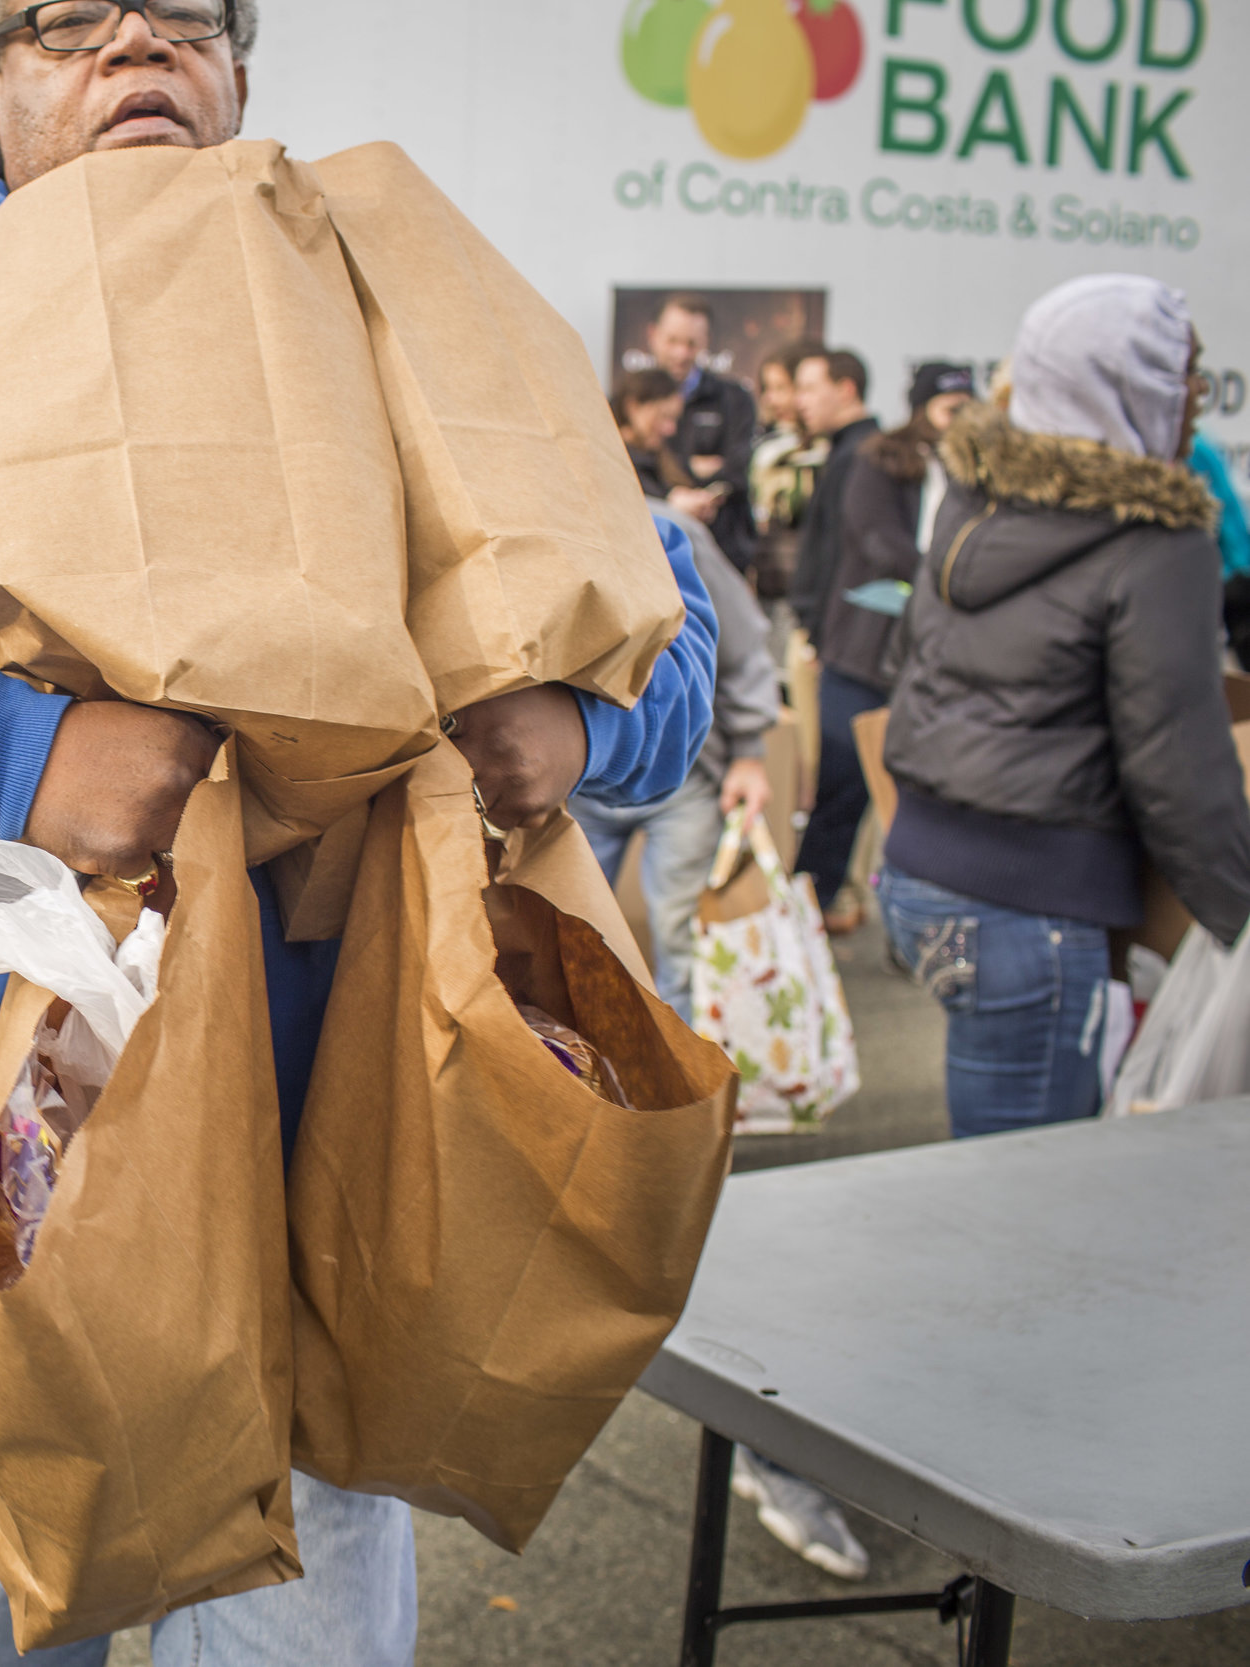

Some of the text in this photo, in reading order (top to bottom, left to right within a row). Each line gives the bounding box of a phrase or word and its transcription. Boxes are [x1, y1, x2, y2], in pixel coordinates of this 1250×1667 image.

[879, 57, 1198, 181] BANK
[613, 159, 1201, 252] of Contra Costa & Solano
